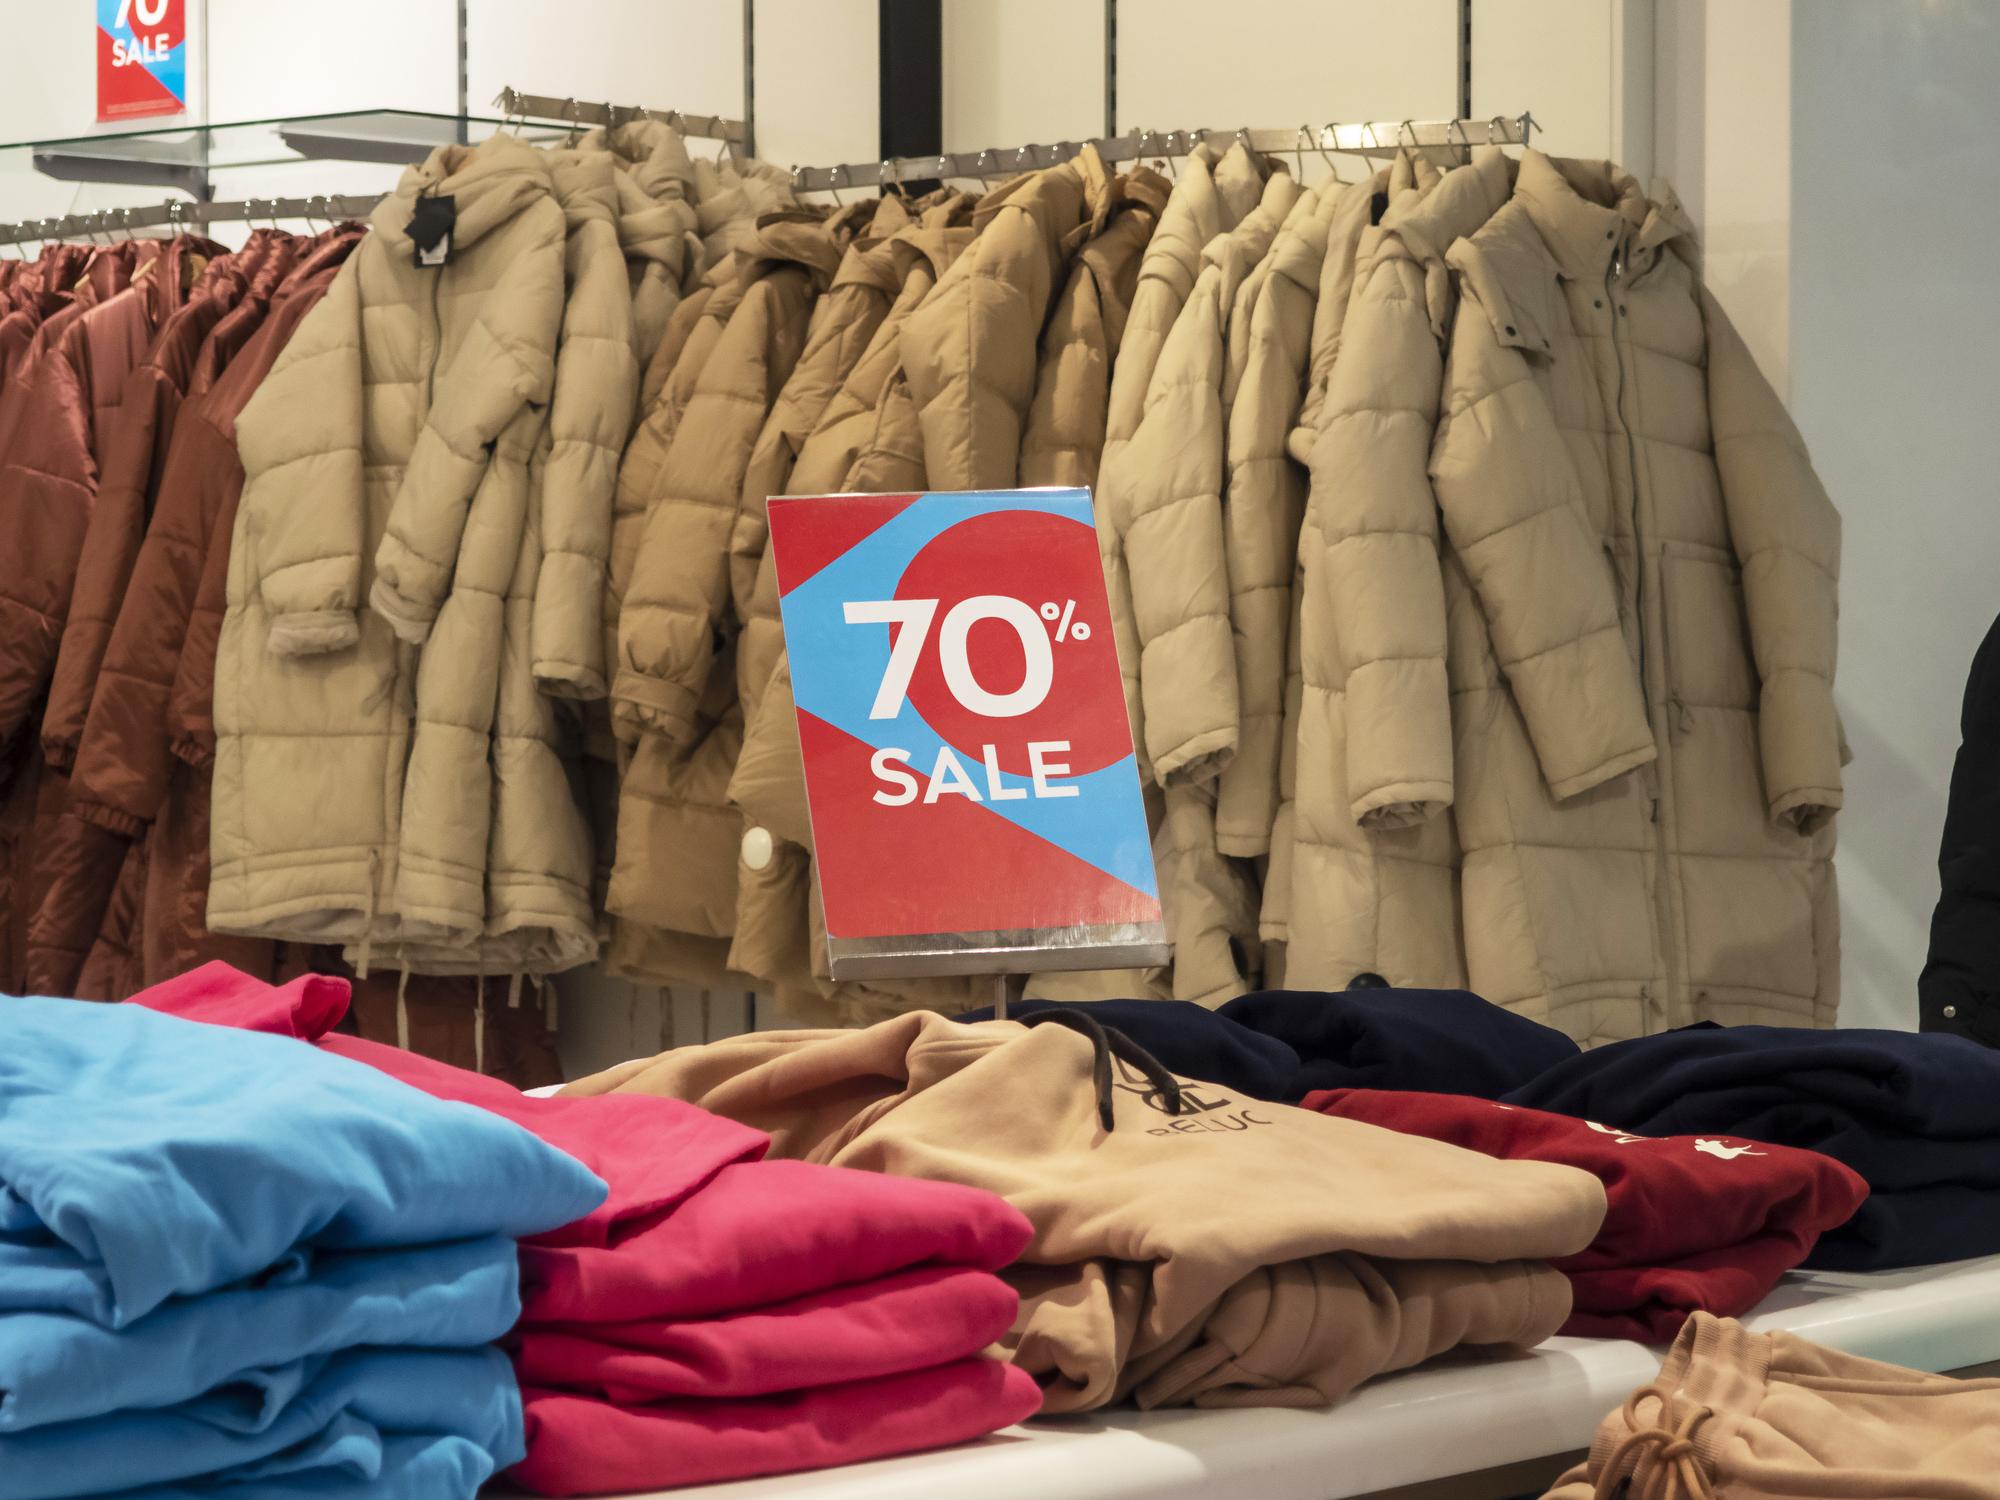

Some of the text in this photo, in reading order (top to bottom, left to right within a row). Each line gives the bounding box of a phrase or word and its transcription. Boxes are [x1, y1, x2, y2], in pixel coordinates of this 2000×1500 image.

[112, 33, 170, 67] SALE
[842, 595, 1091, 720] 70%
[870, 741, 1079, 806] SALE
